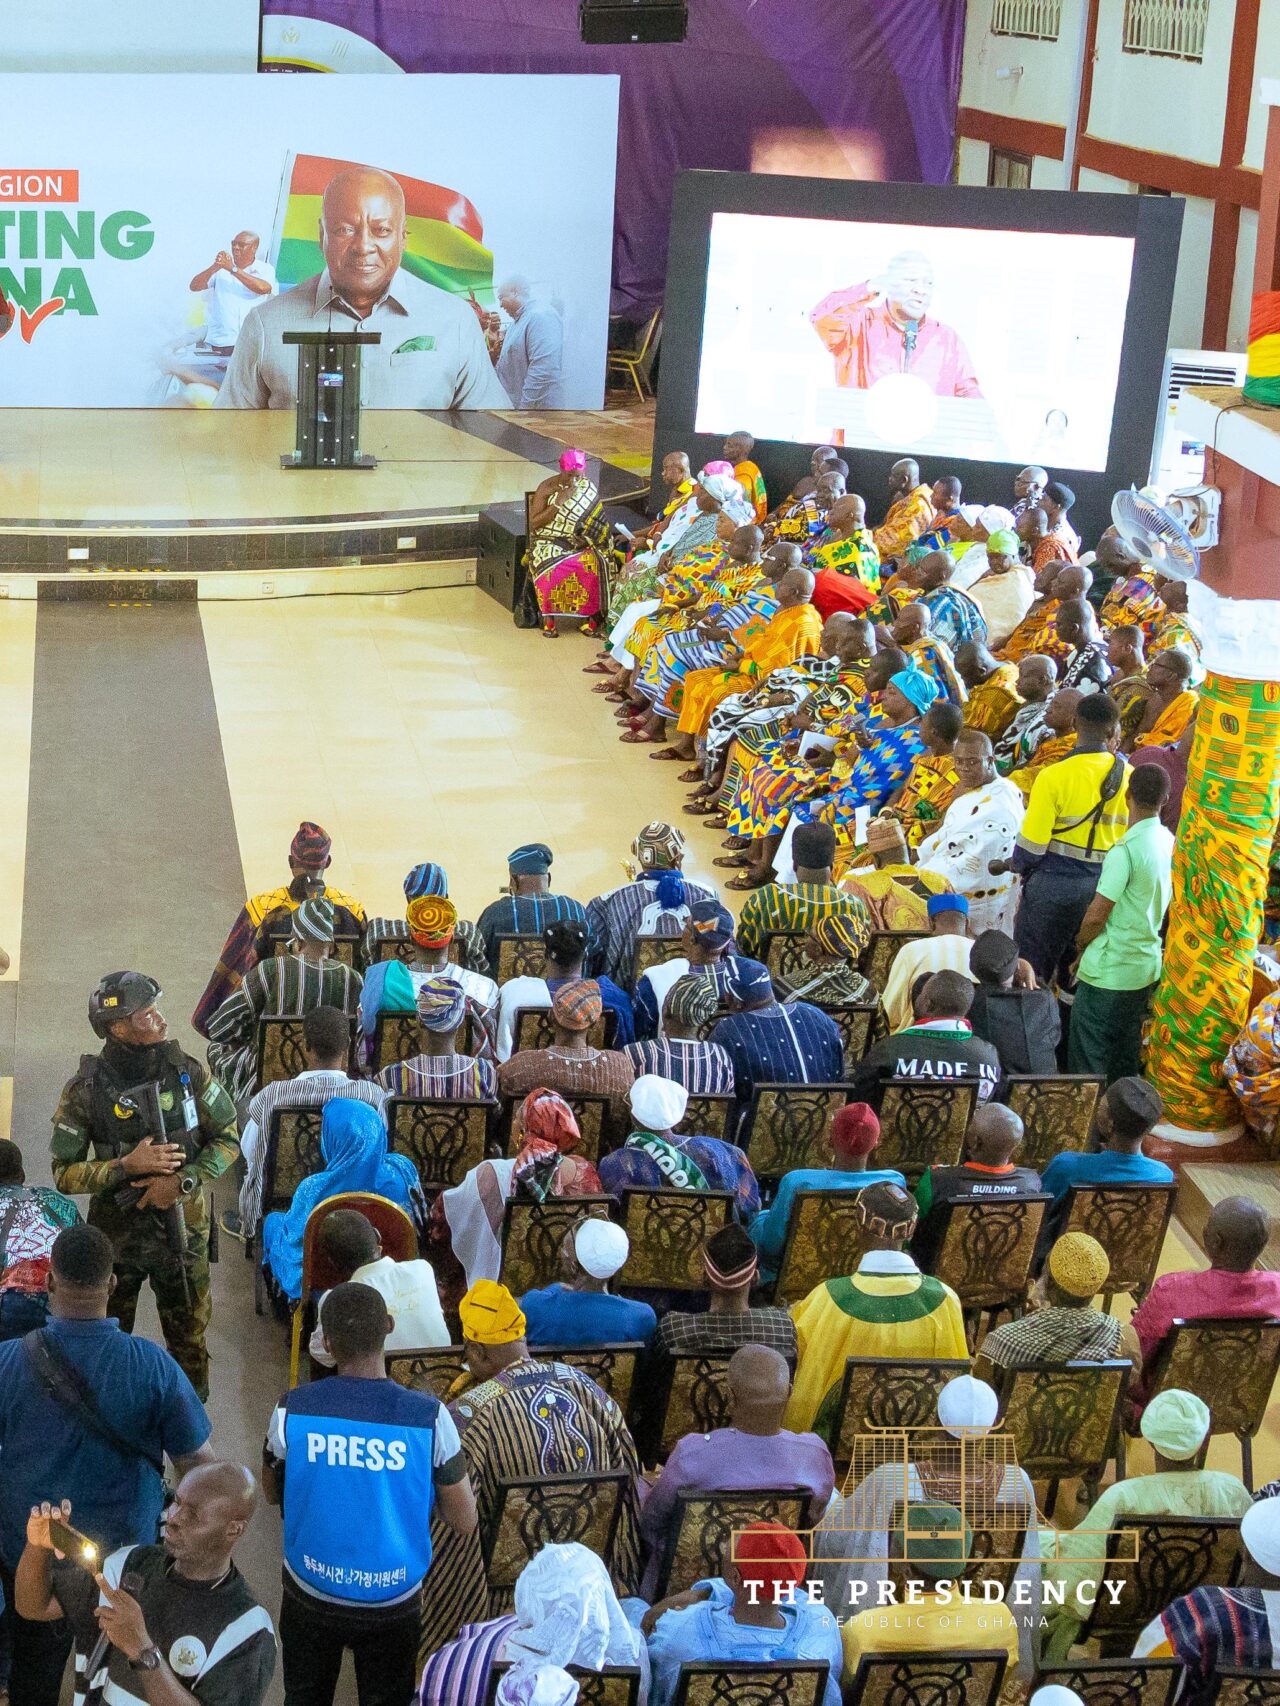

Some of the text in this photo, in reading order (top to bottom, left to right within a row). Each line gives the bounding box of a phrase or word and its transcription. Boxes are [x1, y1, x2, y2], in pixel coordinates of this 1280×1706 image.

[896, 1058, 998, 1083] MADE IN
[972, 1184, 1018, 1194] BUILDING
[307, 1432, 407, 1472] PRESS
